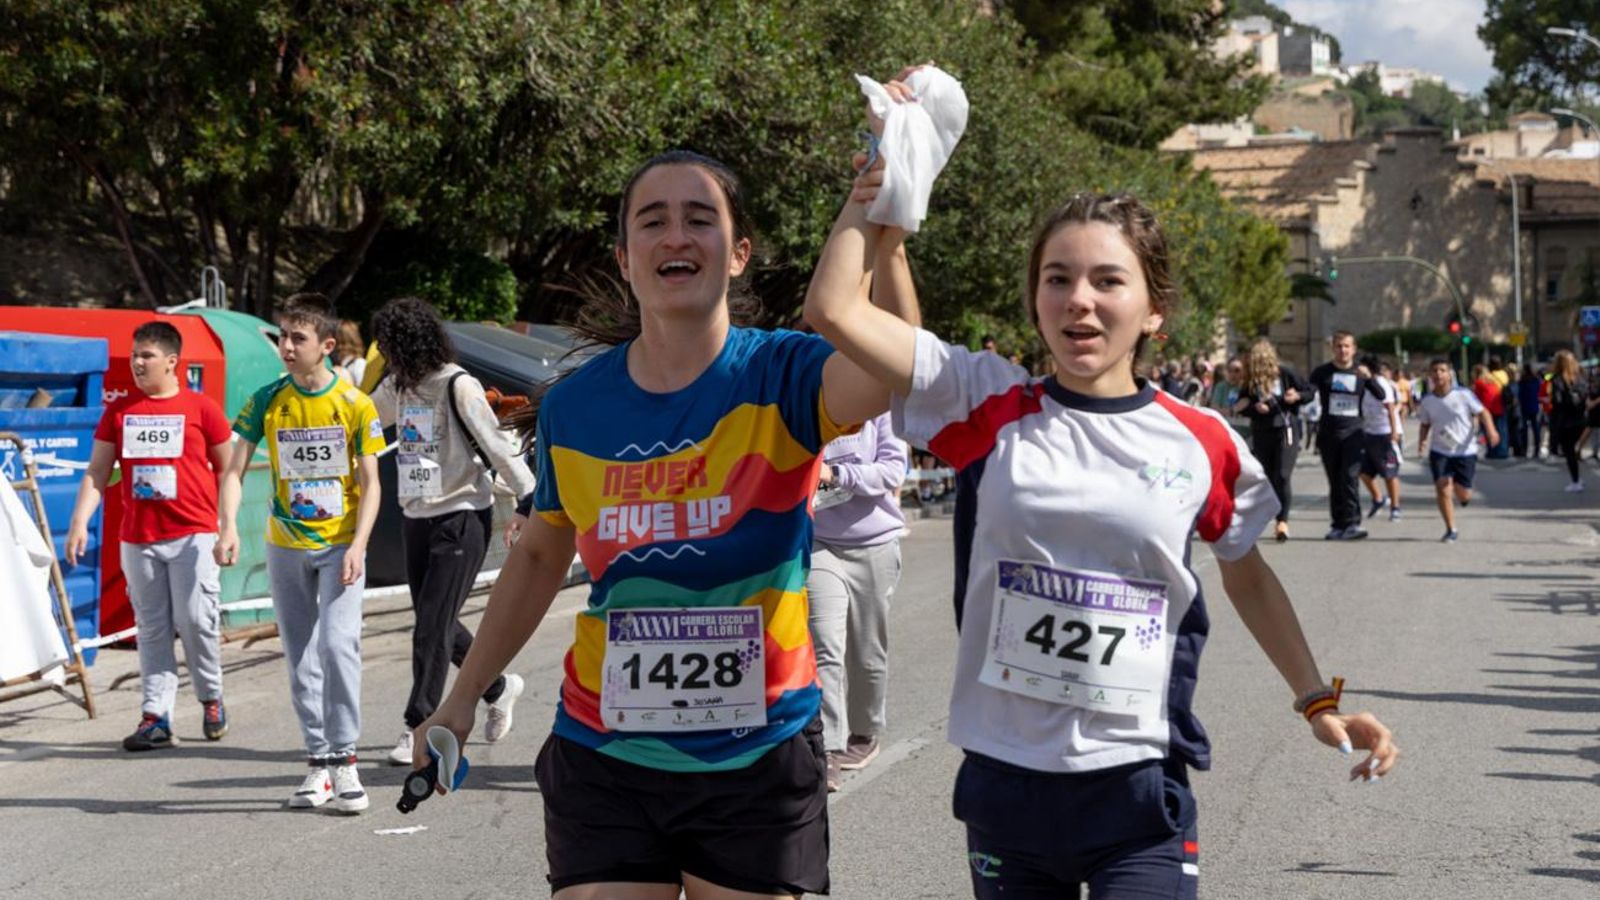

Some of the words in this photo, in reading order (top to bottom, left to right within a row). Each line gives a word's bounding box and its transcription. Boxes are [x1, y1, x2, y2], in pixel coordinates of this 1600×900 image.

[136, 430, 170, 443] 469
[293, 445, 332, 462] 453
[409, 468, 430, 482] 460
[602, 455, 708, 499] NEVER
[687, 495, 731, 537] UP
[1092, 593, 1106, 606] LA
[631, 615, 680, 638] XXXVI
[680, 615, 717, 626] CARRERA
[718, 614, 755, 625] ESCOLAR
[687, 626, 700, 637] LA
[706, 625, 745, 636] GLORIA
[1025, 613, 1127, 666] 427
[622, 652, 743, 690] 1428
